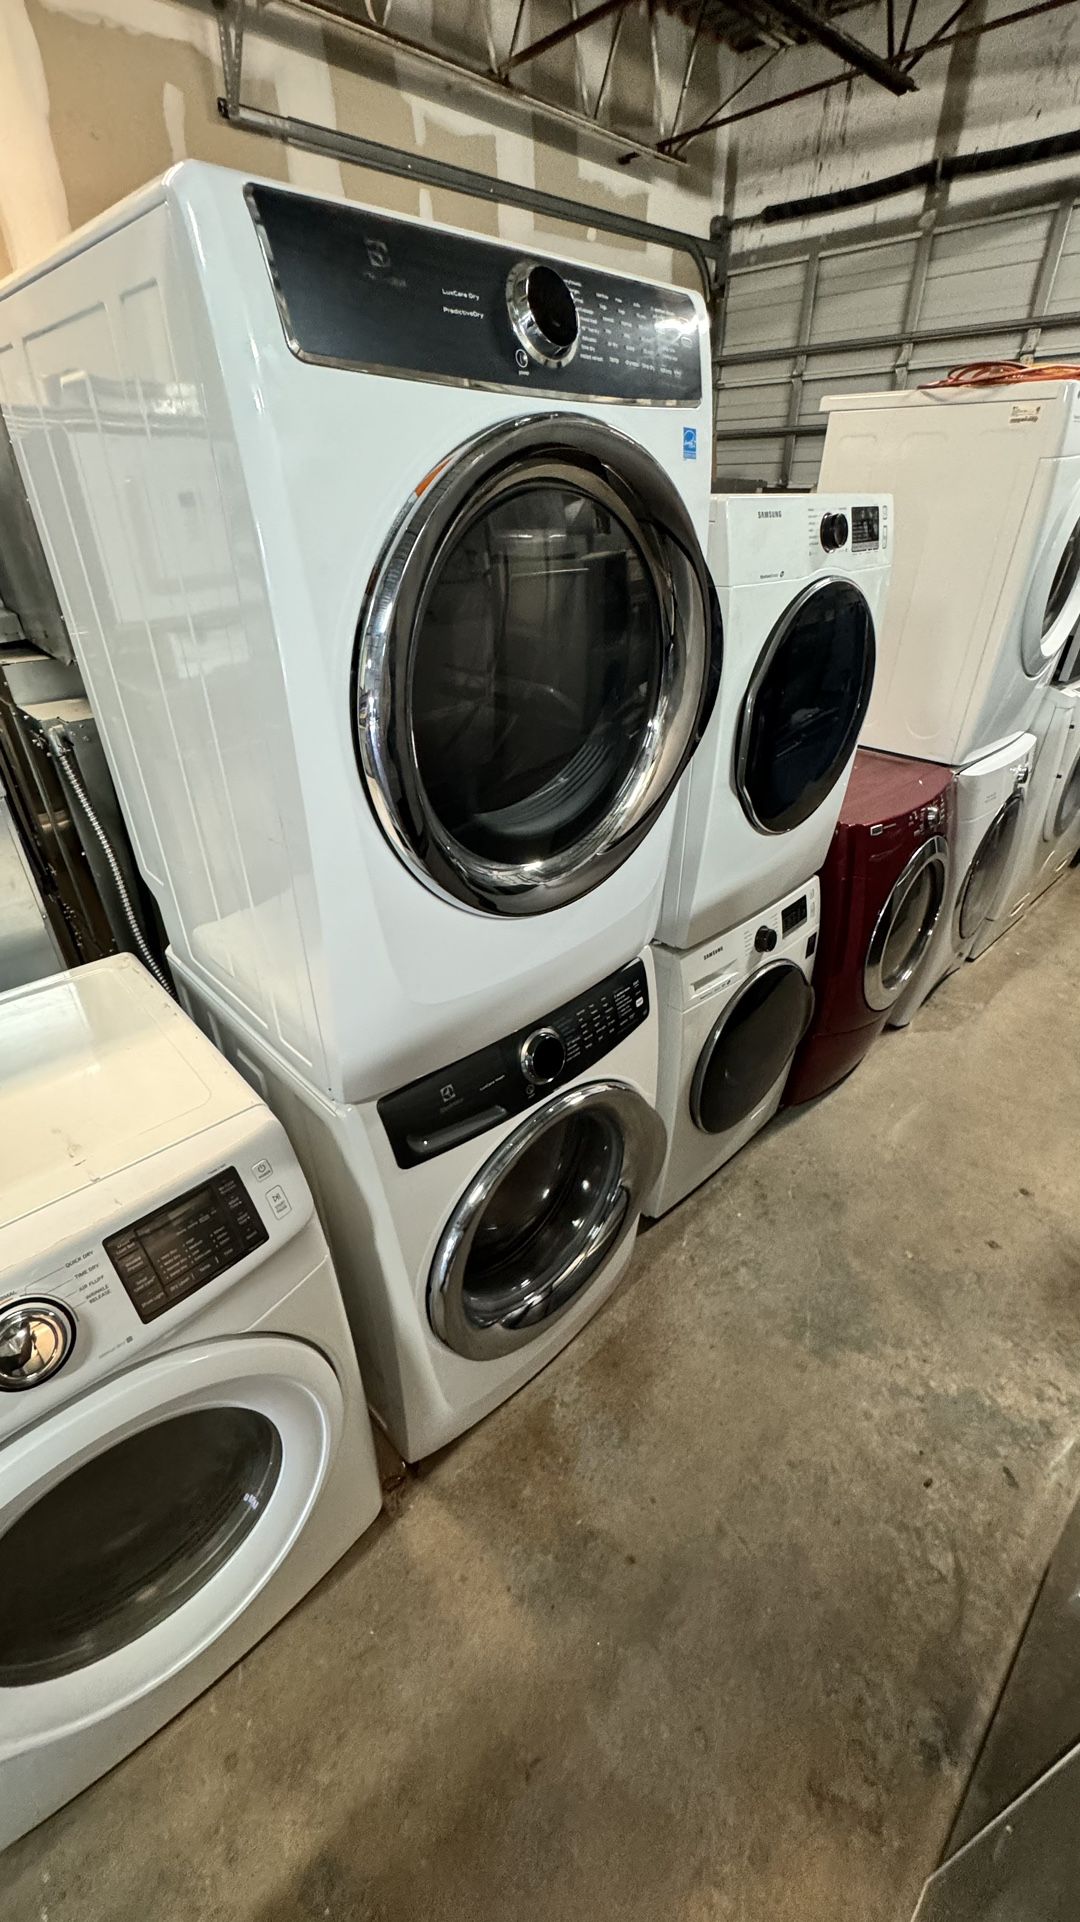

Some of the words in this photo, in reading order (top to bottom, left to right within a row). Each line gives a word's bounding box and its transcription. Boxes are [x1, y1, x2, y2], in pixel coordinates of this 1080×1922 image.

[468, 292, 480, 301] Dry
[442, 306, 485, 319] PredictiveDry
[757, 510, 782, 519] SAMSUNG
[703, 945, 724, 961] SAMSUNG
[65, 1256, 82, 1269] QUICK
[82, 1250, 94, 1260] DRY
[74, 1269, 88, 1279] TIME
[88, 1263, 99, 1272] DRY
[88, 1274, 104, 1287] FLUFF
[89, 1289, 110, 1304] RELEASE
